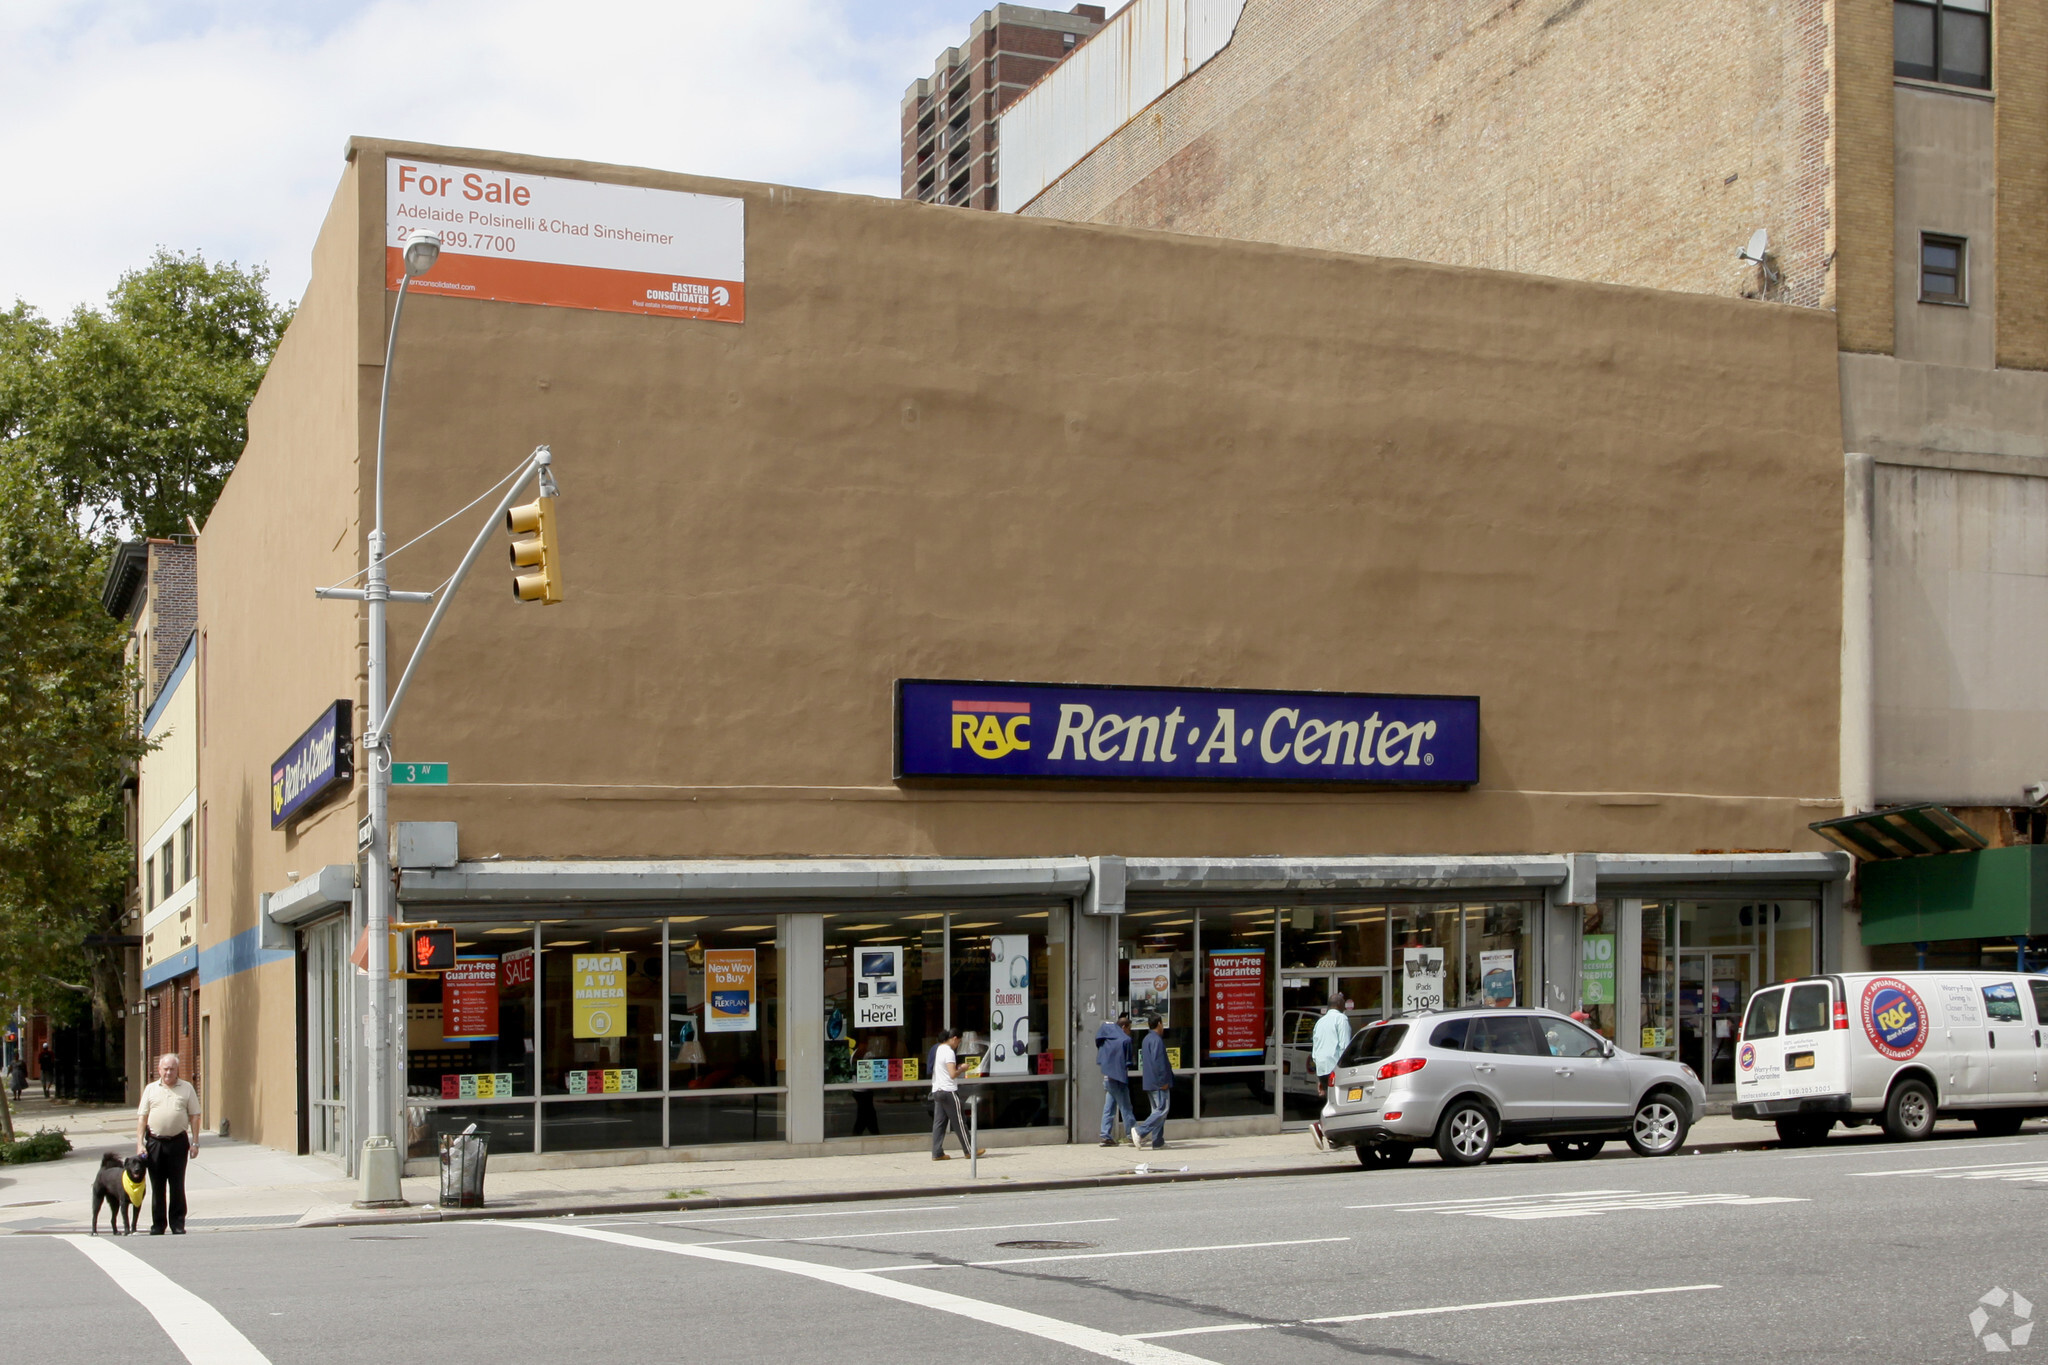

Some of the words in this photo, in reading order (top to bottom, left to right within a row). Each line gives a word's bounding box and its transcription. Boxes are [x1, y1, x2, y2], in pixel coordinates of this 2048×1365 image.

[399, 165, 453, 197] For
[462, 173, 531, 206] Sale
[396, 203, 464, 223] Adelaide
[469, 210, 535, 230] Polsinelli
[538, 218, 549, 232] &
[550, 219, 589, 236] Chad
[593, 224, 674, 245] Sinsheimer
[672, 282, 709, 295] EASTERN
[646, 289, 709, 305] CONSOLIDATED
[952, 713, 1030, 760] RAC
[406, 765, 416, 783] 3
[421, 765, 432, 774] AV
[1582, 939, 1612, 961] NO
[455, 962, 496, 971] orry-Free
[576, 956, 624, 973] PAGA
[1213, 957, 1261, 967] Worry-Free
[445, 971, 496, 980] Guarantee
[505, 959, 531, 986] SALE
[708, 963, 730, 973] New
[731, 963, 752, 975] Way
[1213, 966, 1261, 977] Guarantee
[584, 974, 595, 987] A
[715, 973, 726, 983] to
[726, 973, 745, 984] Buy.
[1415, 983, 1432, 991] iPads
[1870, 980, 1906, 993] APPLIANCES
[575, 988, 625, 999] MANERA
[995, 994, 1022, 1005] COLORFUL
[715, 999, 747, 1008] FLEXPLAN
[871, 1003, 893, 1011] They're
[861, 1008, 897, 1023] Here!
[1863, 996, 1877, 1038] FURNITURE
[1877, 1001, 1912, 1031] RAC
[1911, 994, 1927, 1043] ELECTRONICS
[1879, 1043, 1916, 1058] COMPUTERS
[1754, 1065, 1780, 1073] Worry-Free
[1754, 1073, 1780, 1081] Guarantee
